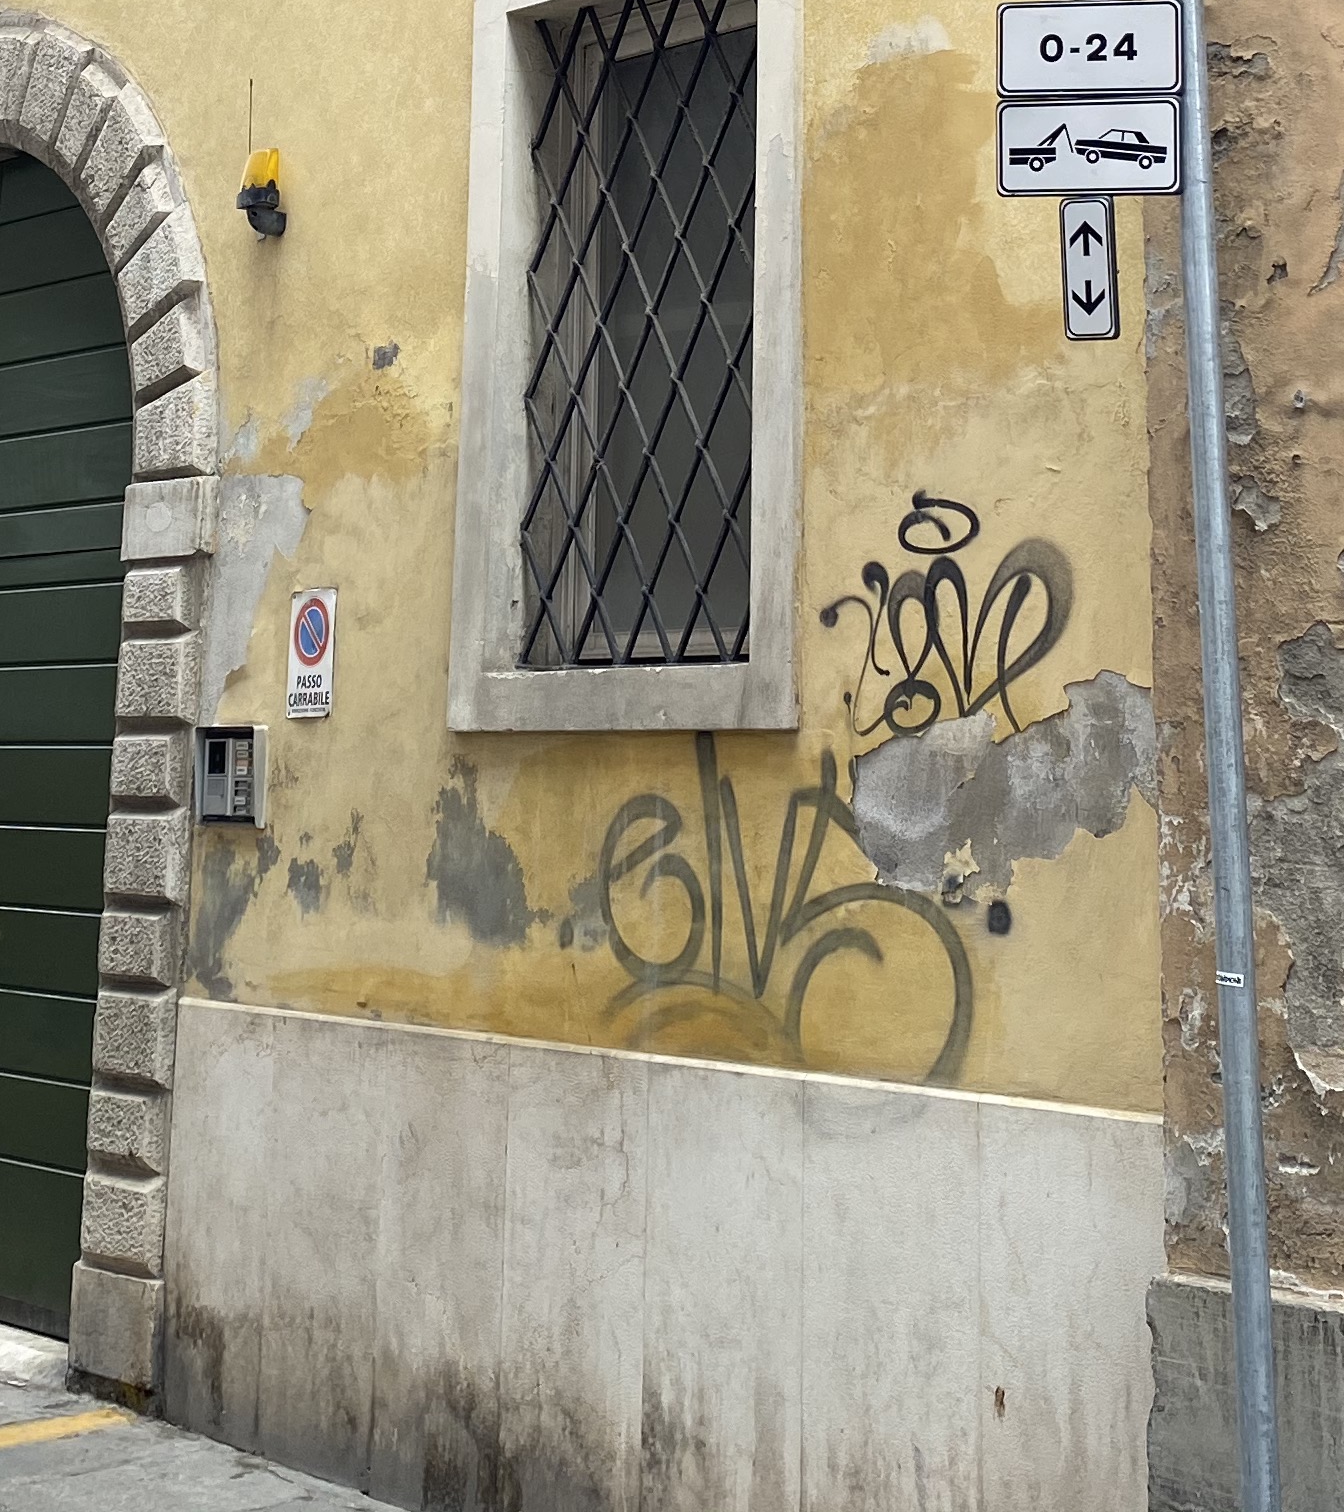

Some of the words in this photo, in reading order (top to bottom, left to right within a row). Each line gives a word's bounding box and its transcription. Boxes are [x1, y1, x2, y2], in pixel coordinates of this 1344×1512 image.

[1039, 32, 1138, 63] 0-24
[296, 674, 323, 690] PASSO
[288, 690, 330, 707] CARRABILE
